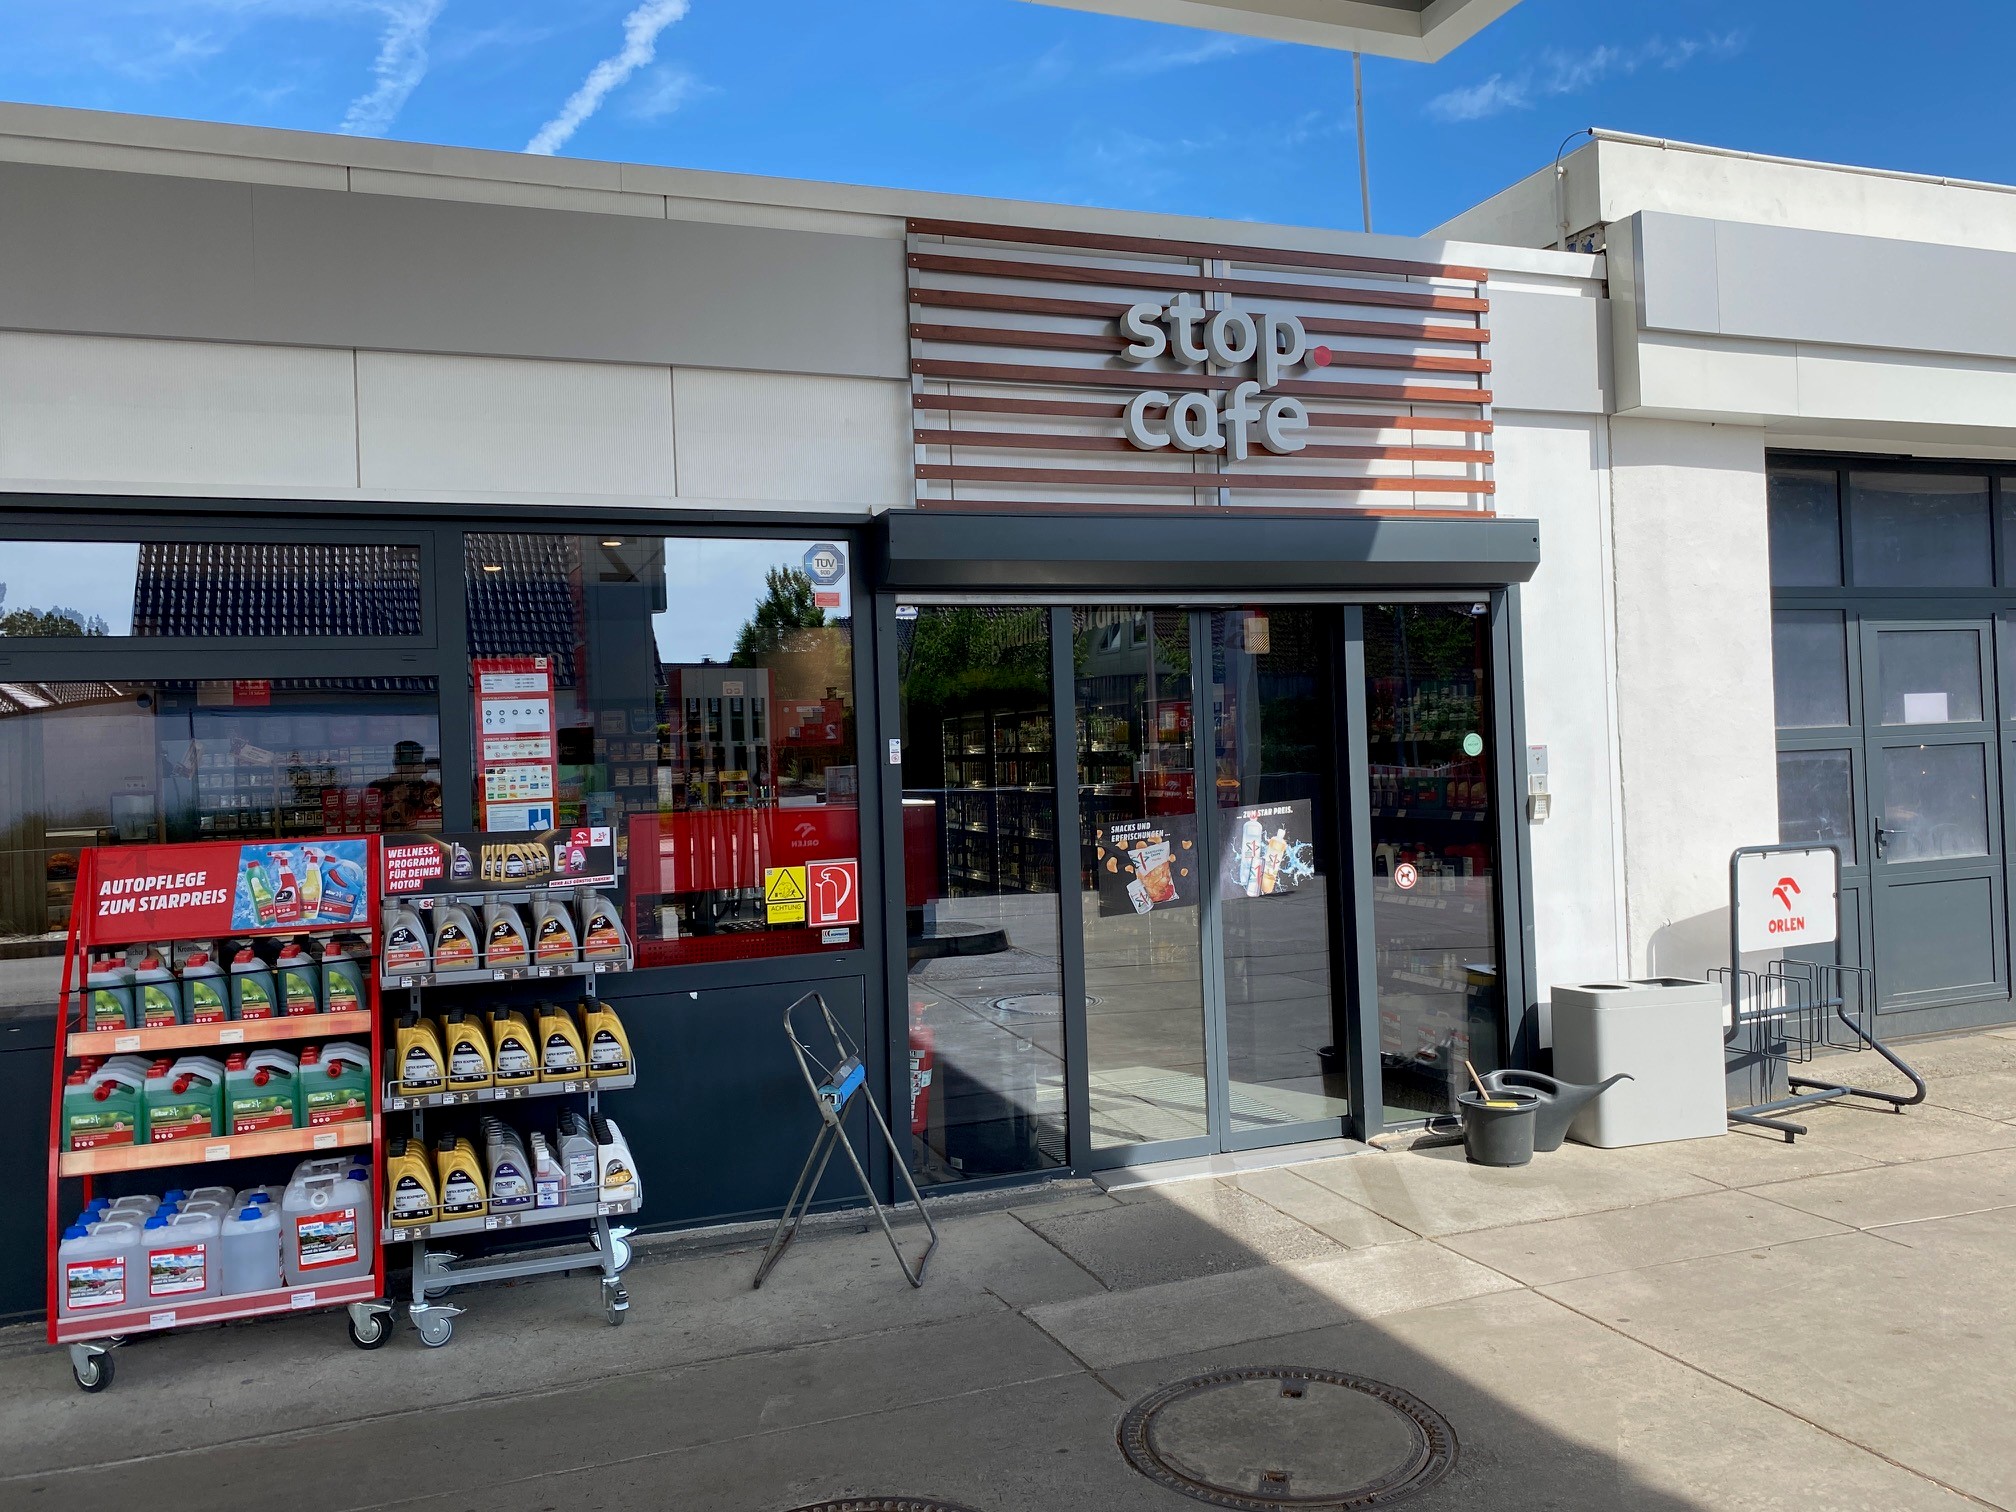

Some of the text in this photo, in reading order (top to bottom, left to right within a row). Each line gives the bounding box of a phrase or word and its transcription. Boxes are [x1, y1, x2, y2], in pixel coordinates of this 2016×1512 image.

[1121, 292, 1332, 388] stop.
[1123, 380, 1309, 463] cafe
[815, 558, 835, 568] TÜV
[1243, 810, 1256, 819] ZUM
[1257, 808, 1273, 817] STAR
[1274, 806, 1293, 815] PREIS.
[1111, 822, 1151, 833] SNACKS UND
[1111, 829, 1164, 842] ERFRISCHUNGEN
[387, 846, 438, 859] WELLNESS-
[388, 856, 440, 869] PROGRAMM
[389, 866, 441, 880] FÜR DEINEN
[99, 871, 207, 896] AUTOPFLEGE
[390, 879, 421, 890] MOTOR
[98, 888, 228, 916] ZUM STARPREIS
[770, 904, 802, 912] ACHTUNG
[1768, 917, 1805, 934] ORLEN
[495, 1180, 516, 1188] RIDER
[605, 1175, 628, 1183] DOT-5.1
